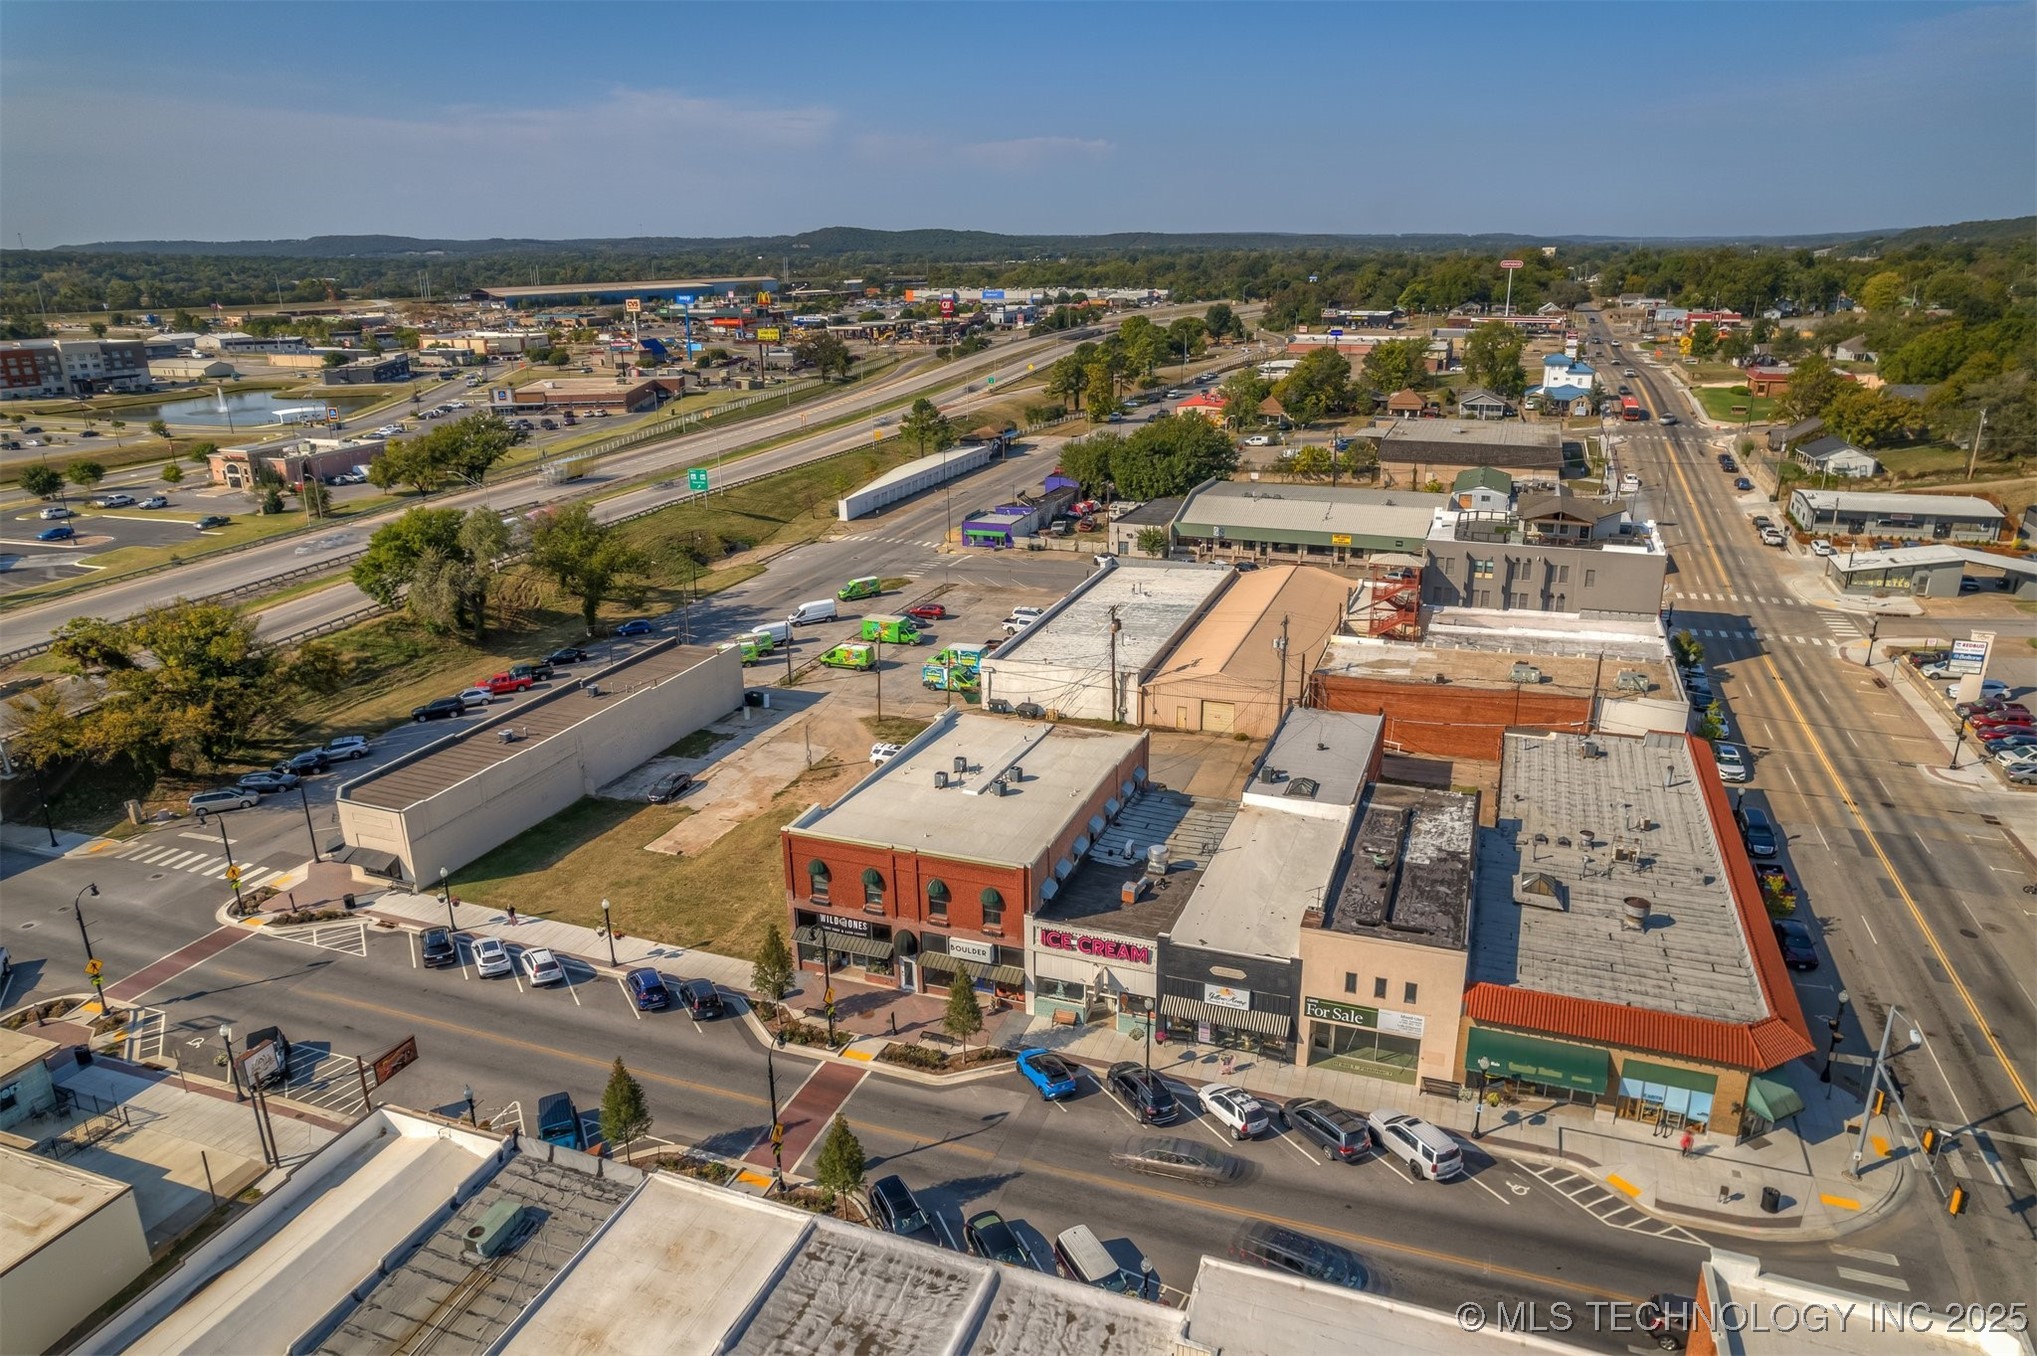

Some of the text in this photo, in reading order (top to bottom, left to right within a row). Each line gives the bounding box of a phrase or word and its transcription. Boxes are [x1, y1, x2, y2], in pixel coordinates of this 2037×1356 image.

[820, 913, 839, 925] WILD
[950, 944, 987, 957] BOULDER
[1040, 929, 1149, 964] ICE CREAM
[1306, 1003, 1364, 1024] For Sale
